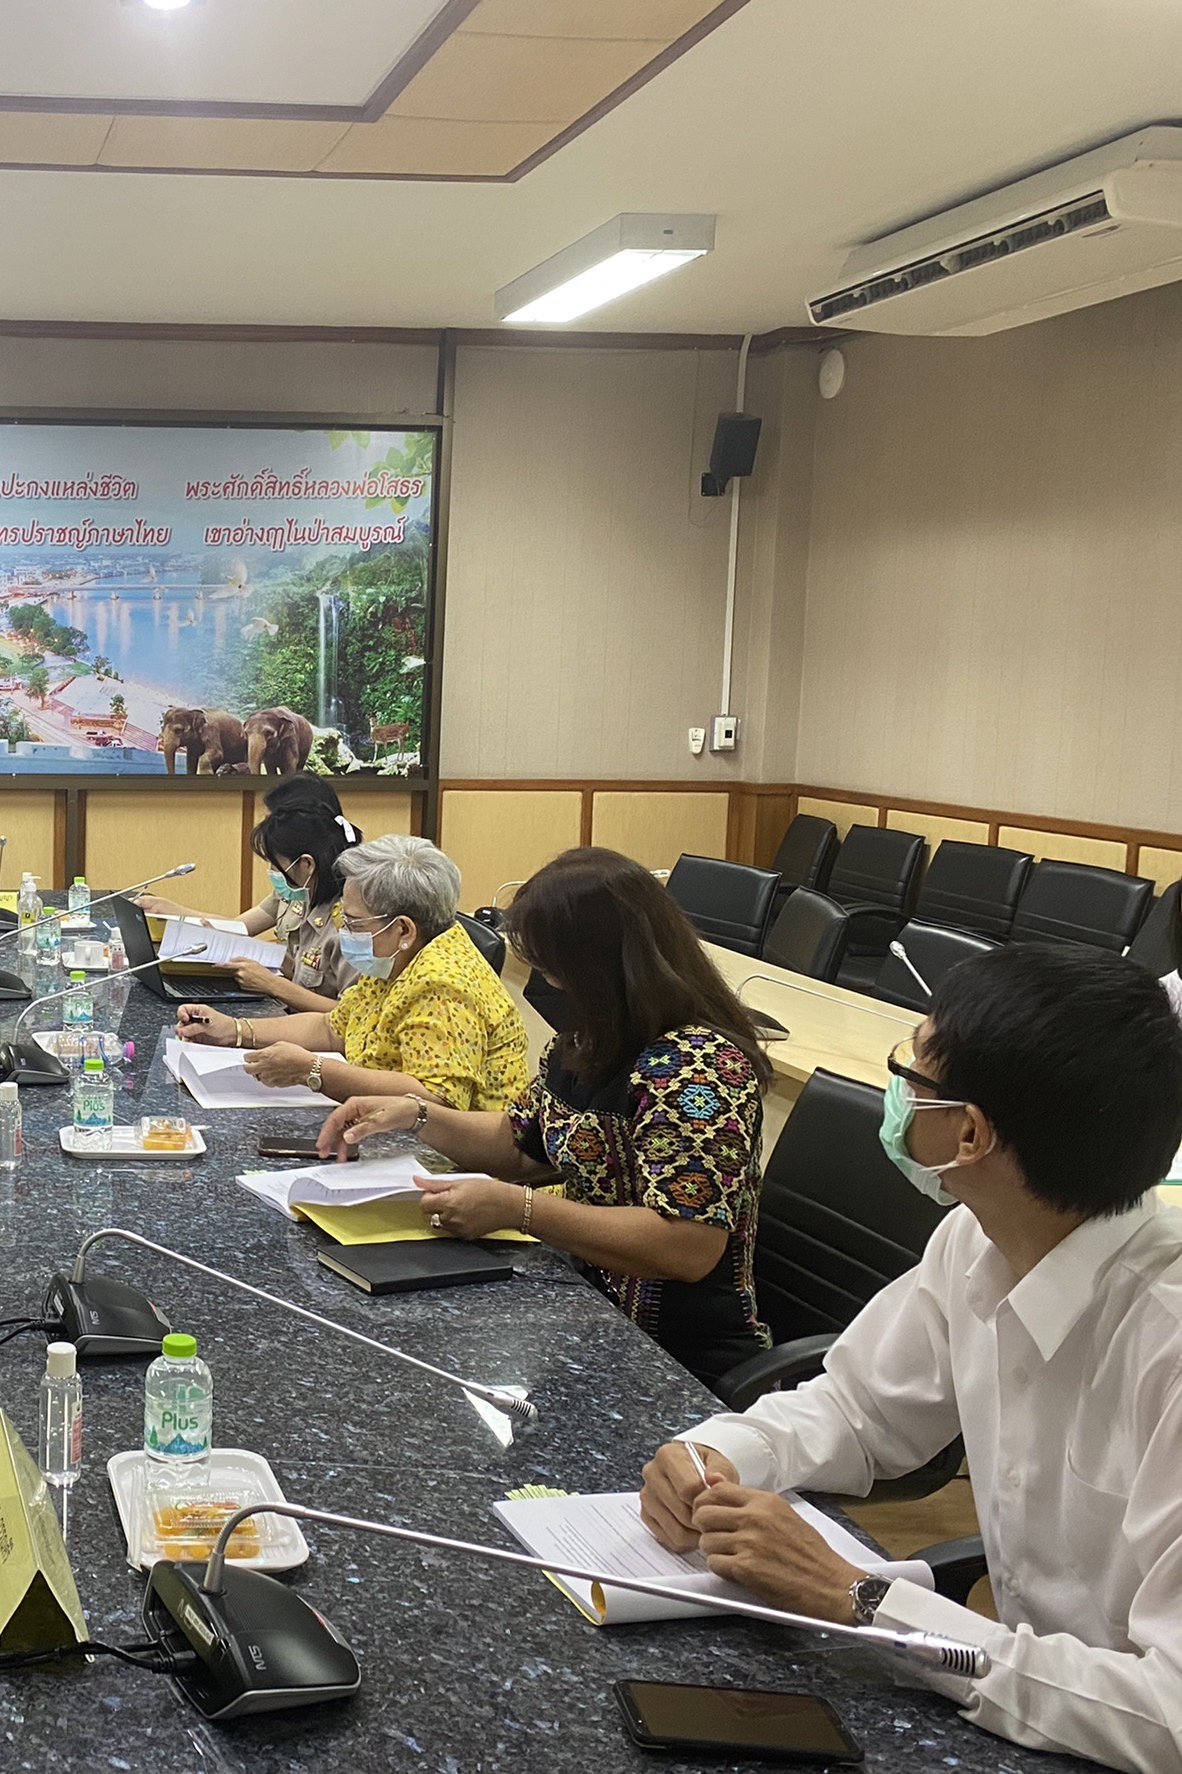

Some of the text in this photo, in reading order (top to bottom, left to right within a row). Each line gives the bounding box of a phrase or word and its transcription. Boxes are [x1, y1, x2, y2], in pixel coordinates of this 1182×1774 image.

[185, 467, 423, 499] พระศักดิ์สิทธิ์หลวงพ่อโสธร
[82, 1099, 105, 1112] Plus
[161, 1411, 198, 1431] Plus
